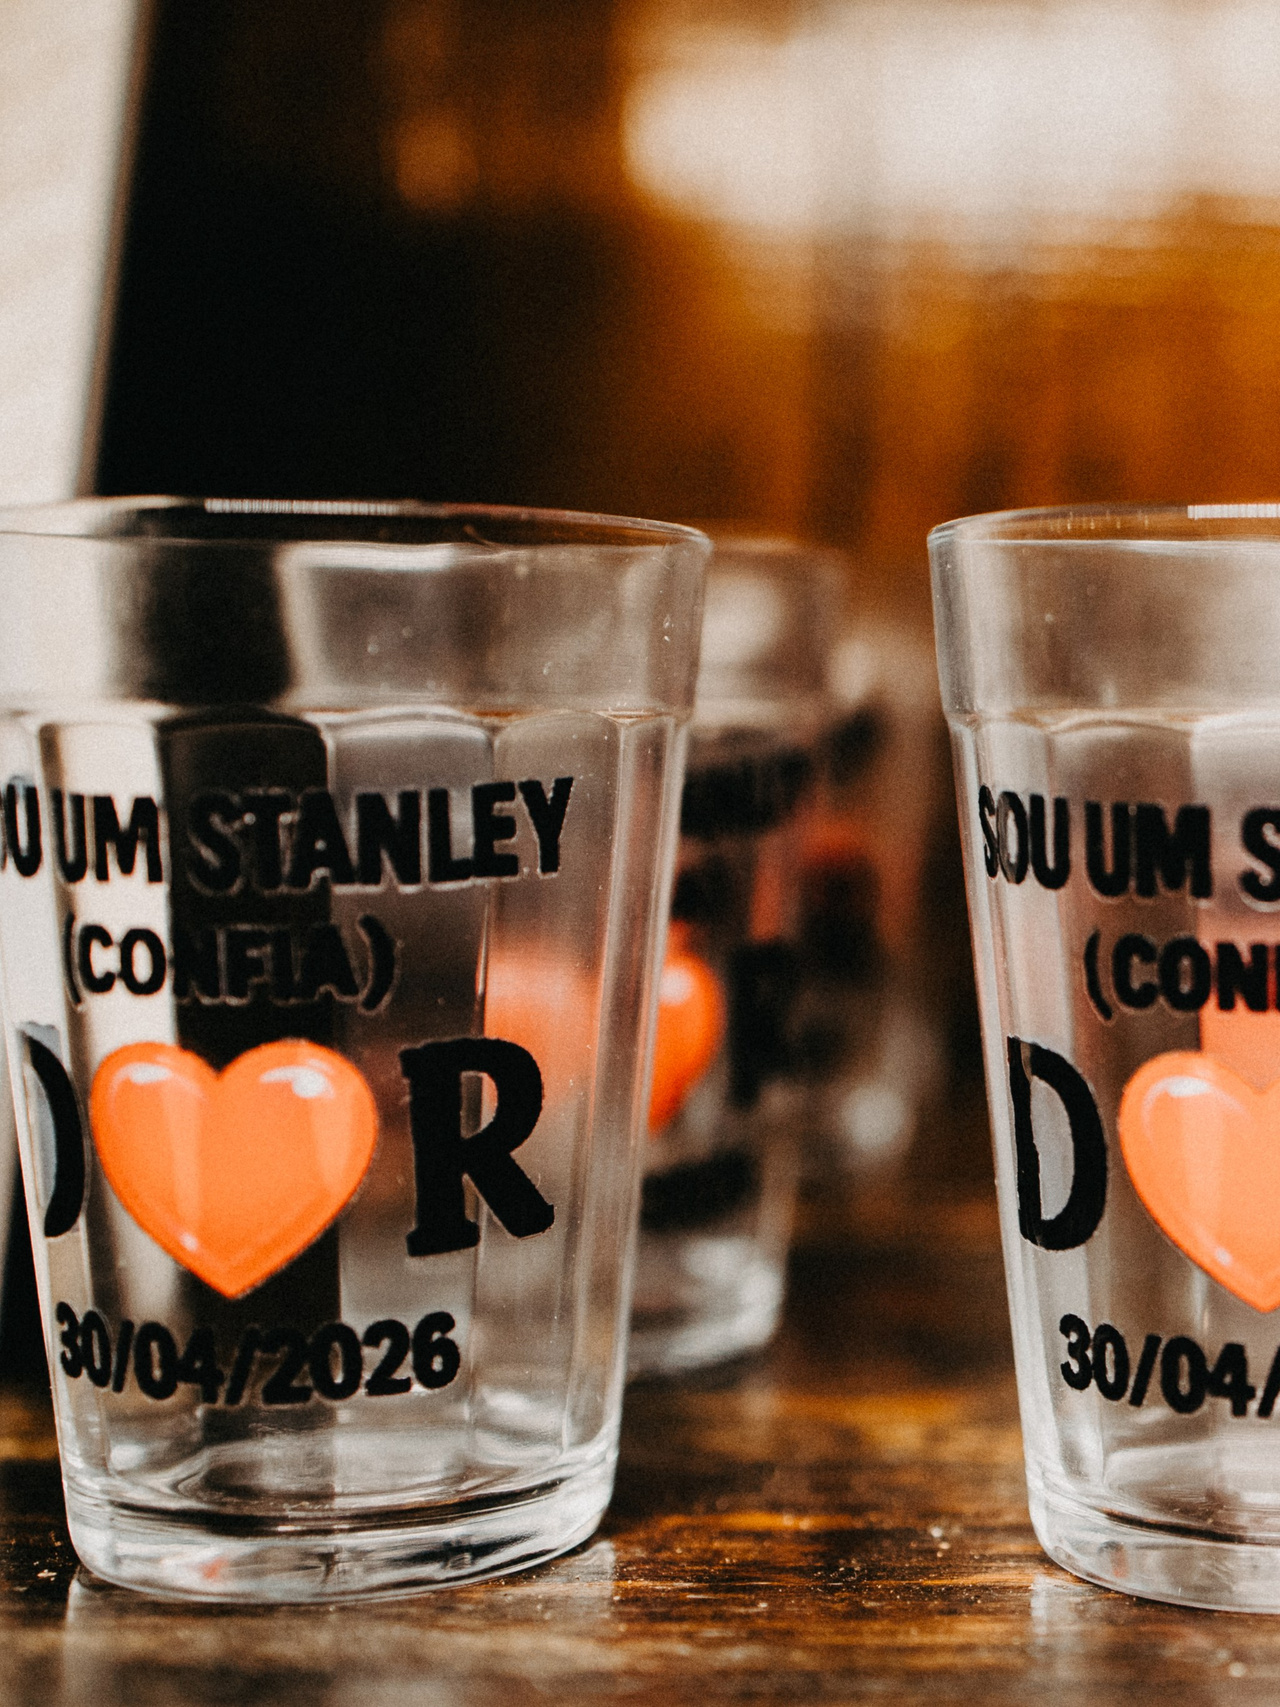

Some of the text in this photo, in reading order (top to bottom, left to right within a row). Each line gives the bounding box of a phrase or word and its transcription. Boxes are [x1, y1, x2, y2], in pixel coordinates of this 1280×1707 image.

[52, 788, 164, 883] UM
[187, 777, 573, 892] STANLEY
[978, 786, 1071, 889] SOU
[1085, 802, 1212, 900] UM
[66, 914, 395, 1010] (CONFIA)
[401, 1038, 554, 1256] R
[1007, 1036, 1107, 1251] D
[57, 1303, 460, 1403] 30/04/2026
